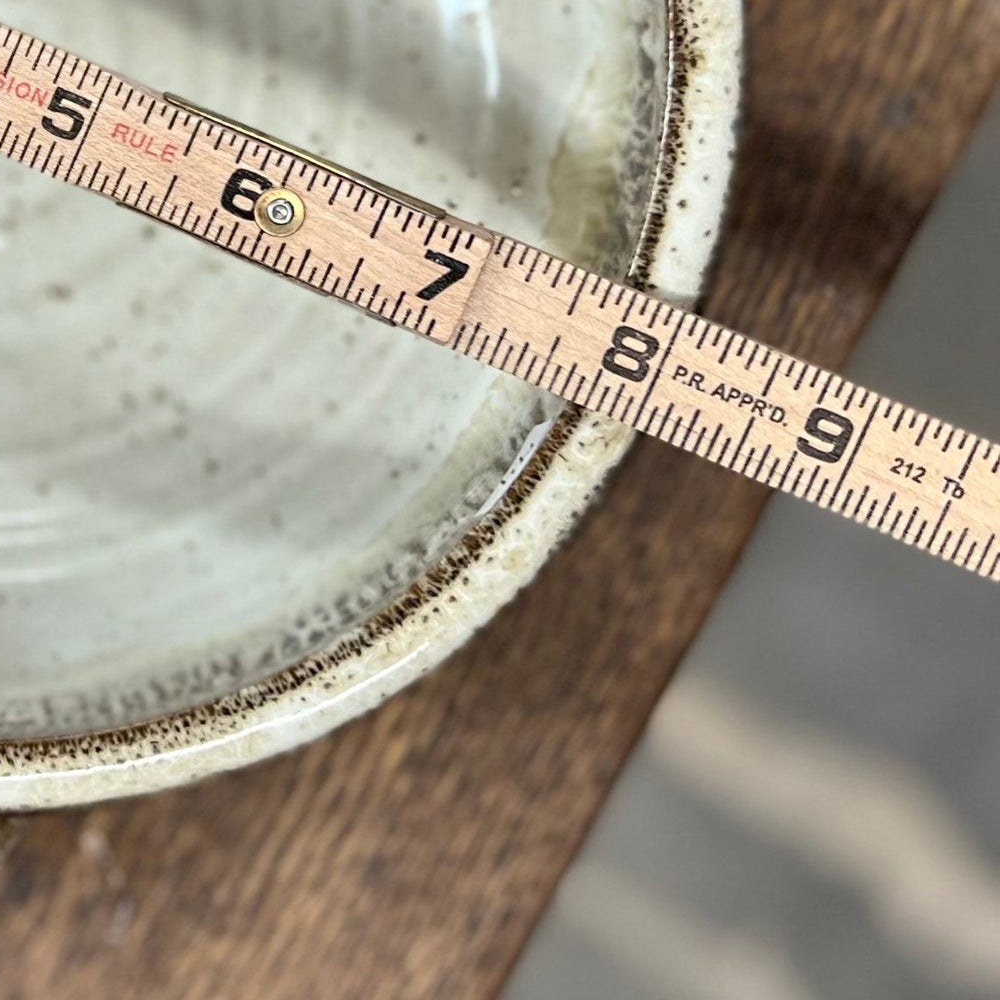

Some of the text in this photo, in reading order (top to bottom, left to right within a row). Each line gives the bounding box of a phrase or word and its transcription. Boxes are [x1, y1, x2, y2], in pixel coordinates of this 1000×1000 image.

[41, 87, 93, 141] 5
[111, 122, 178, 164] RULE
[221, 168, 273, 222] 6
[416, 249, 470, 301] 7
[601, 325, 660, 383] 8
[797, 407, 854, 464] 9
[889, 457, 927, 485] 212
